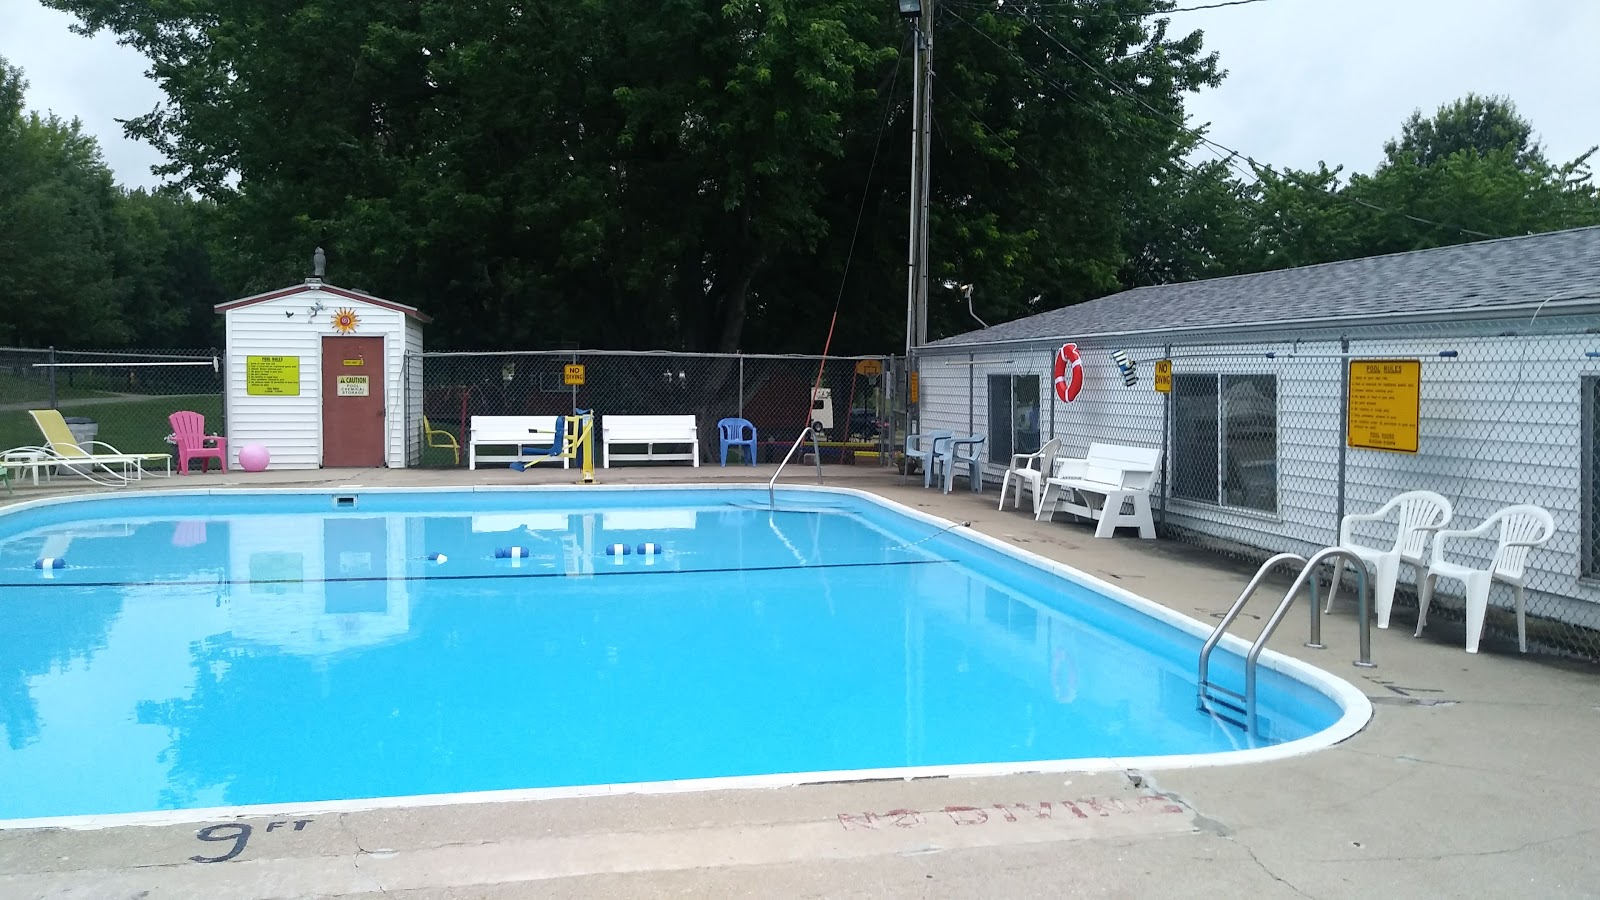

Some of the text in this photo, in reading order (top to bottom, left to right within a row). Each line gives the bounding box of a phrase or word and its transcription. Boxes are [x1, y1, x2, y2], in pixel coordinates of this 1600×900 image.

[1158, 363, 1168, 373] NO
[837, 808, 927, 831] NO
[190, 819, 315, 863] 9 FT
